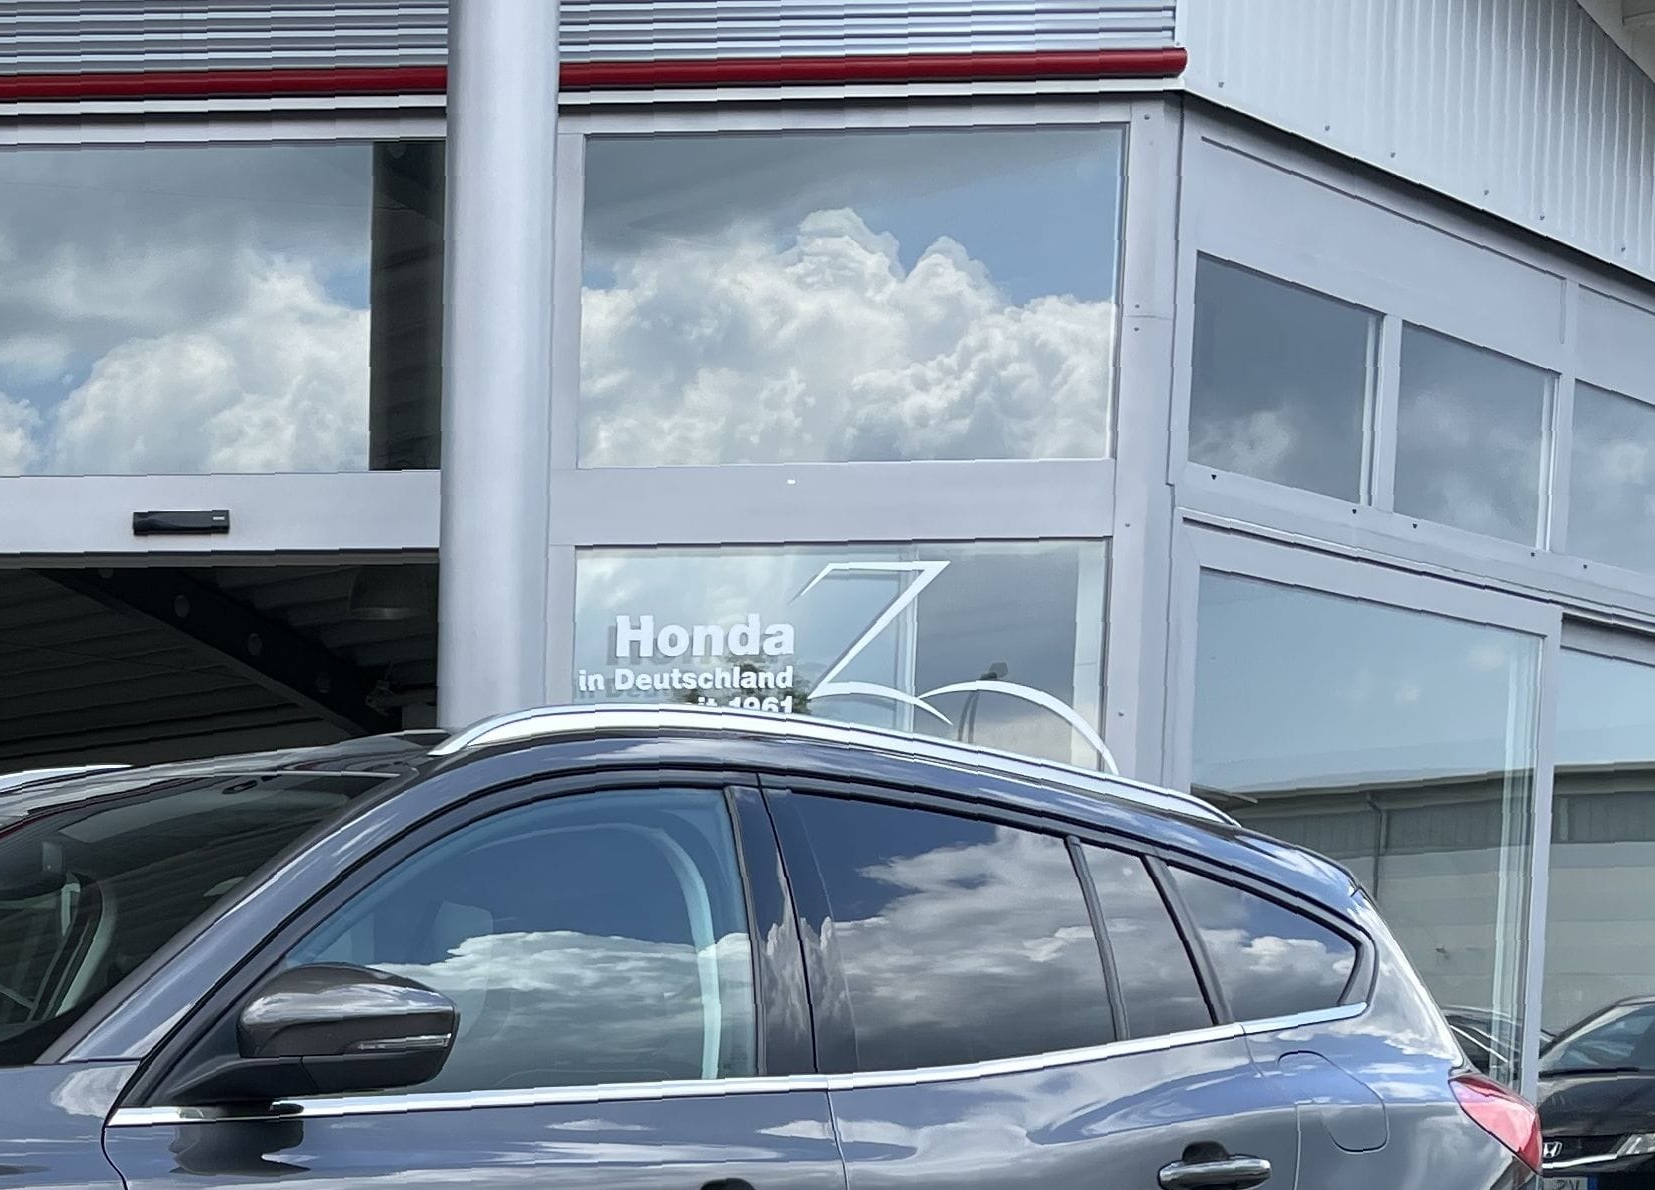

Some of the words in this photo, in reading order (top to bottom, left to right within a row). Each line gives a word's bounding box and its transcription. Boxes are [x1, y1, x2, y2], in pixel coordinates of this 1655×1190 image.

[615, 613, 795, 657] Honda
[578, 669, 605, 692] in
[614, 665, 794, 691] Deutschland
